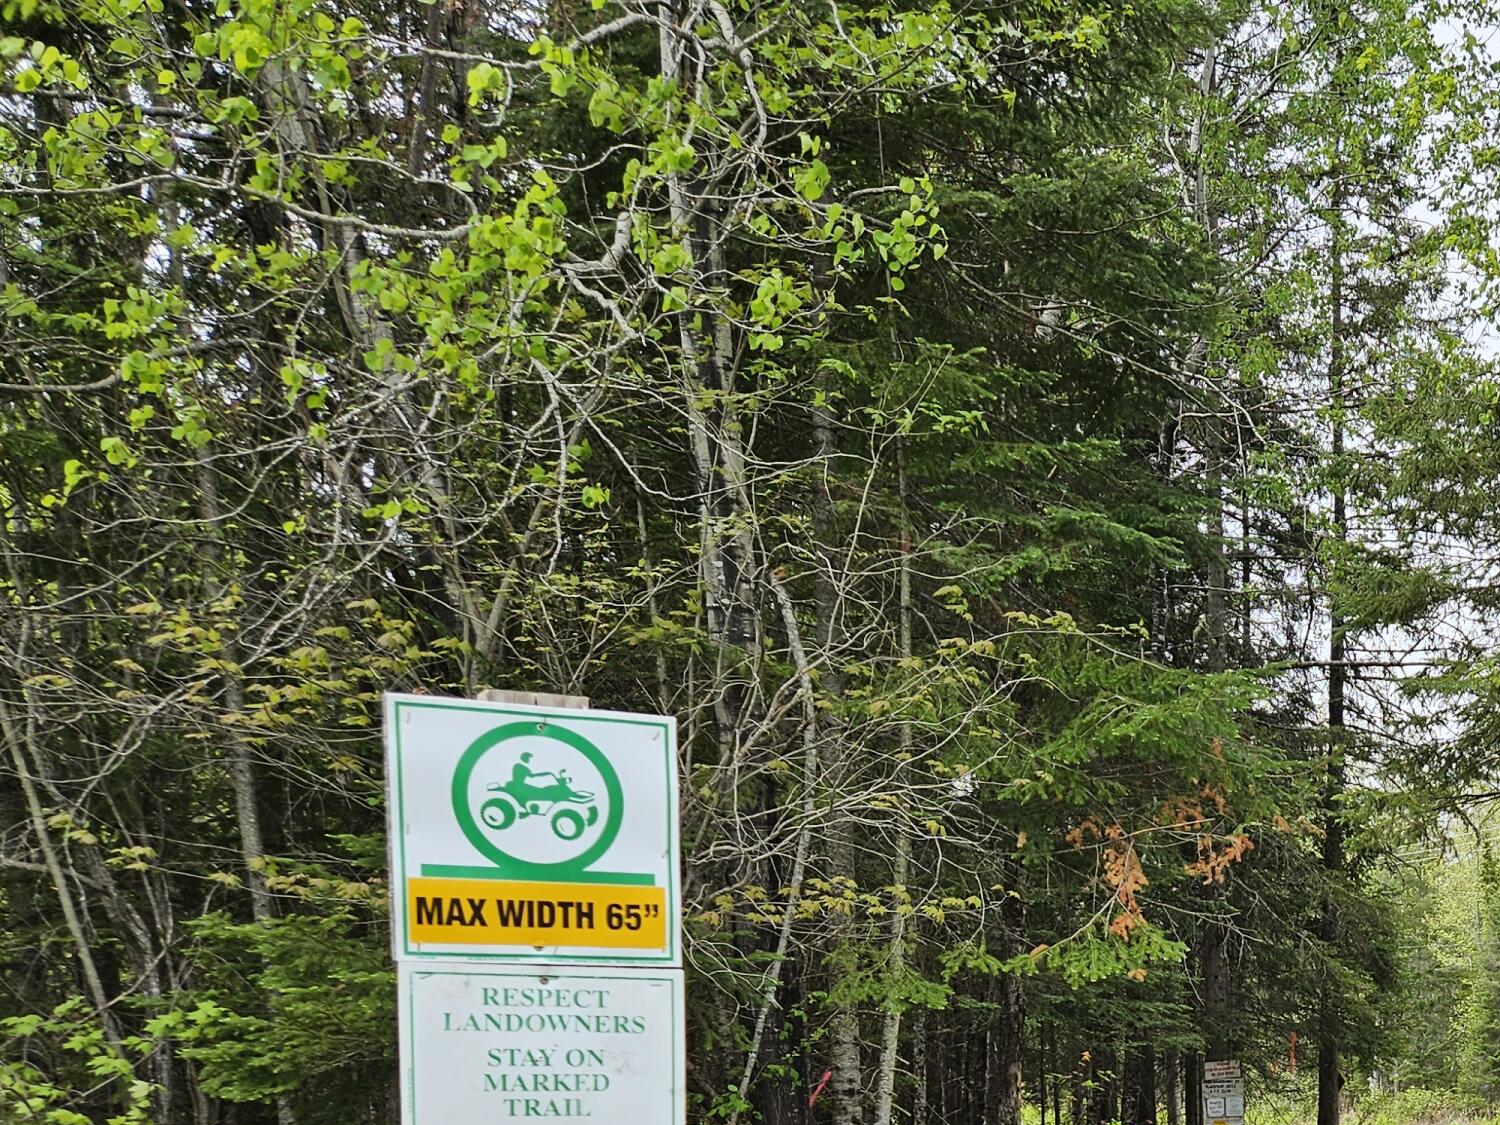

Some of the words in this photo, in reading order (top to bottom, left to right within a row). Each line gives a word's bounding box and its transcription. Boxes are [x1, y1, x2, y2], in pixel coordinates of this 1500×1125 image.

[415, 896, 488, 928] MAX
[496, 899, 595, 930] WIDTH
[481, 987, 610, 1009] RESPECT
[442, 1012, 646, 1034] LANDOWNERS
[487, 1047, 557, 1068] STAY
[565, 1048, 605, 1068] ON
[482, 1073, 610, 1092] MARKED
[503, 1098, 592, 1117] TRAIL
